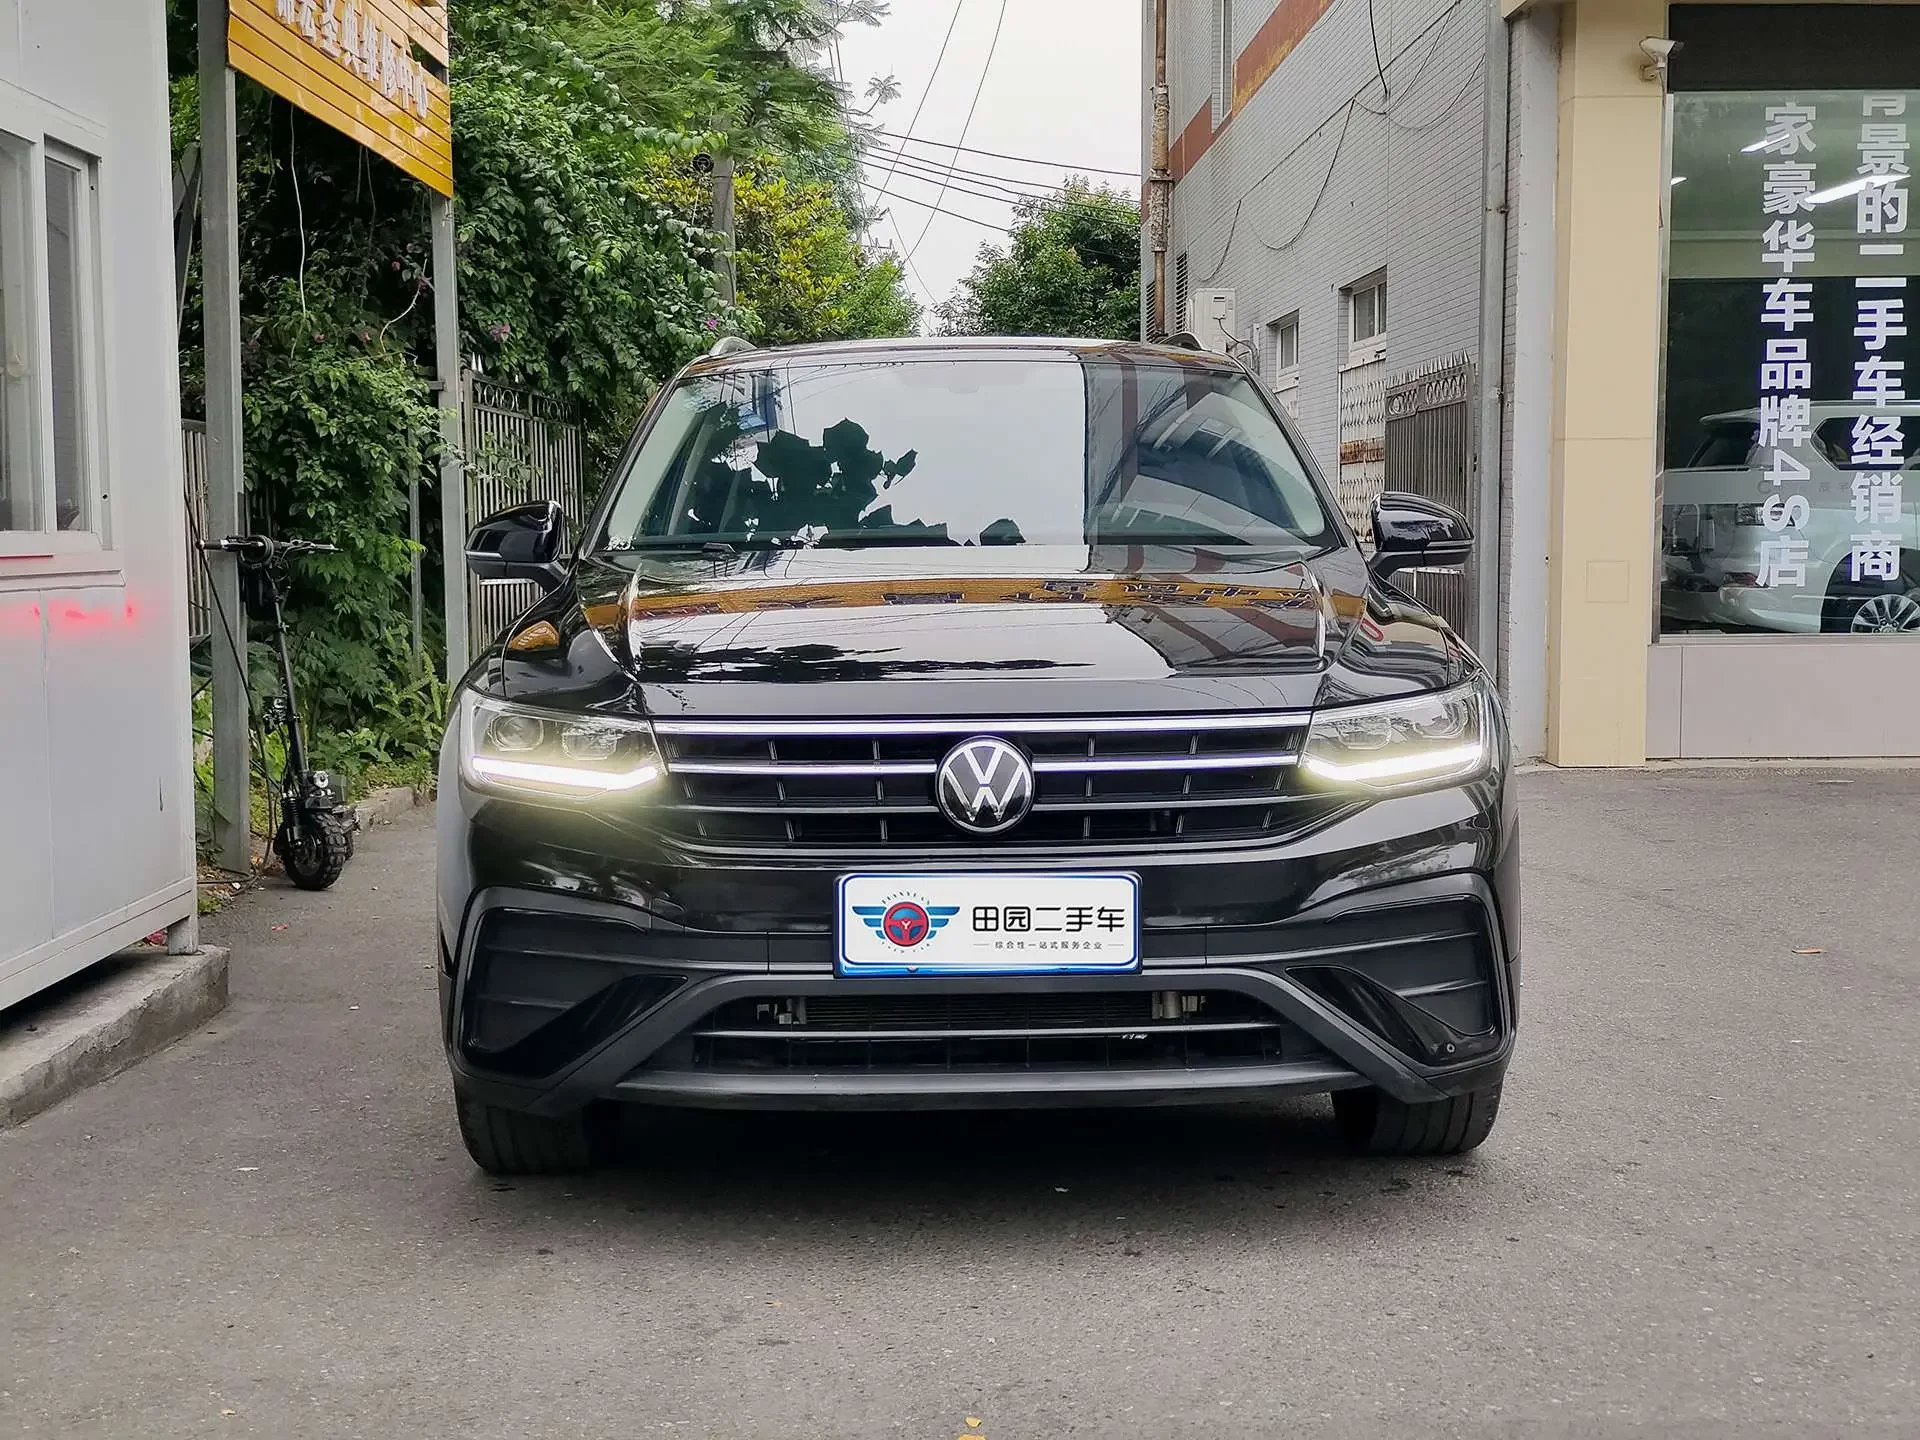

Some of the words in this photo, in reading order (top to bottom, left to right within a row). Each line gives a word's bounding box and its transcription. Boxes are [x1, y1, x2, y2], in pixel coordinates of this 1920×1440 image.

[1755, 101, 1817, 587] 家豪华车品牌4S店
[972, 905, 1126, 933] 田园二手车
[994, 940, 1103, 951] 综合性一站式服务企业
